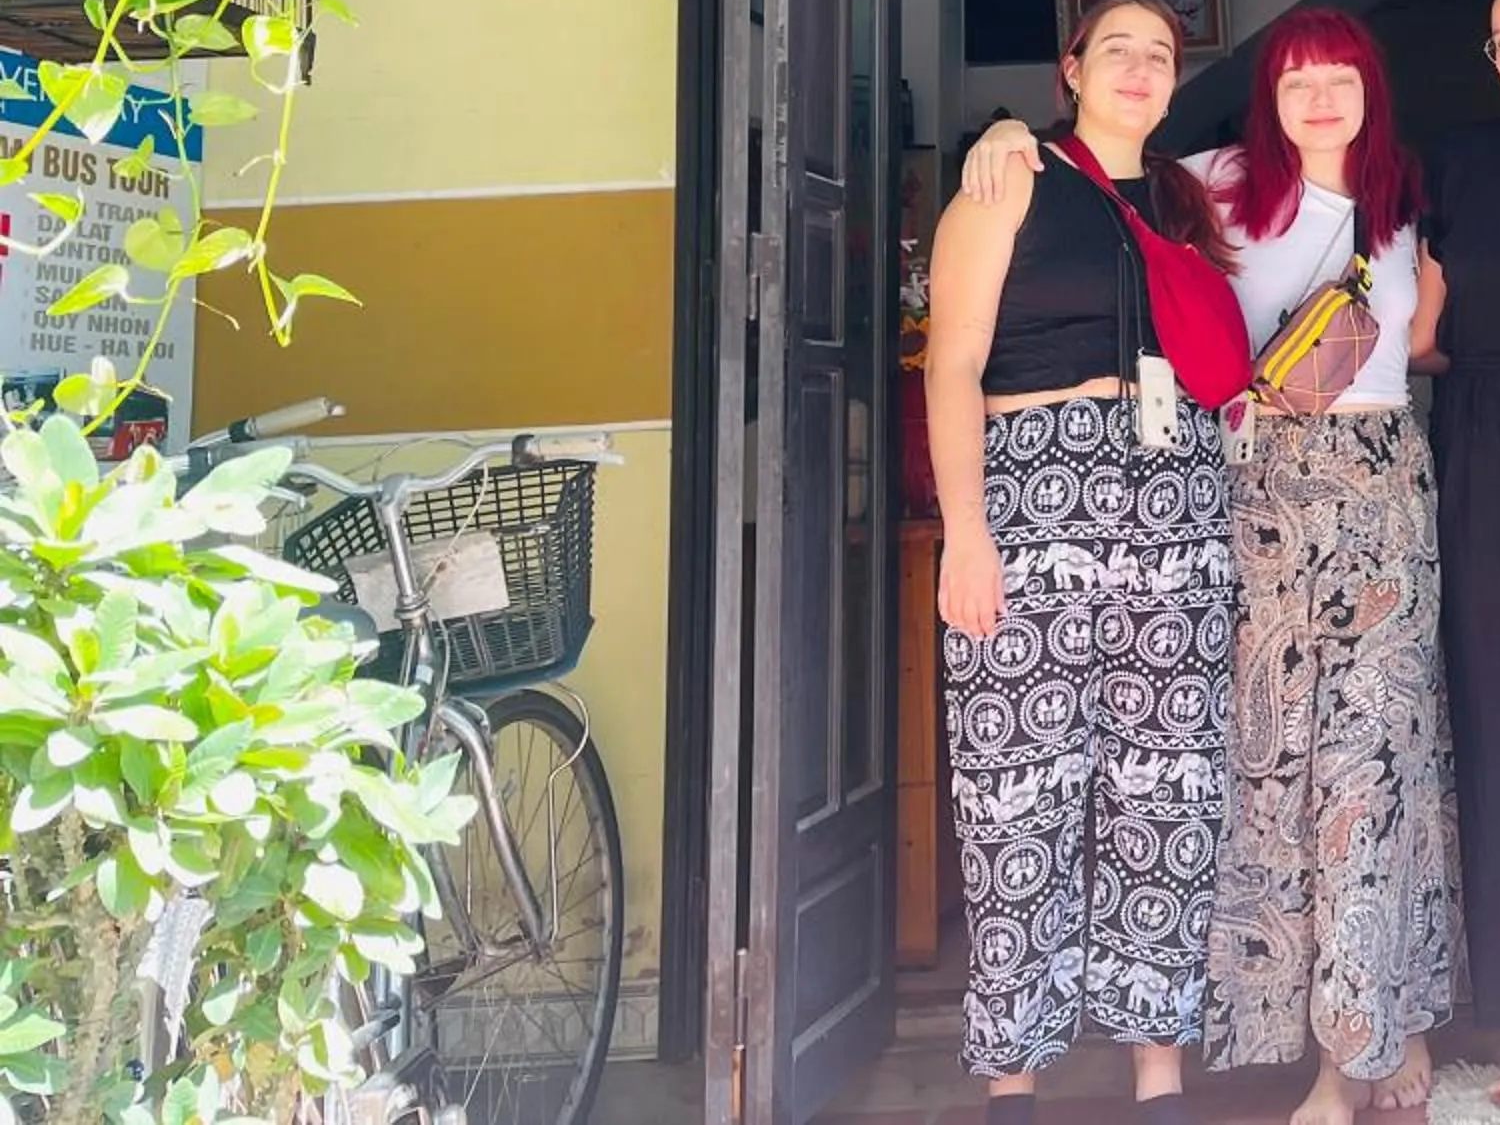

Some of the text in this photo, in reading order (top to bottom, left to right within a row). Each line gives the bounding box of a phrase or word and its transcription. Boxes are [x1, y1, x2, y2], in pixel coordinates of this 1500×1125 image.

[43, 145, 97, 186] BUS
[78, 222, 112, 244] LAT
[88, 314, 150, 335] NHON
[30, 333, 77, 354] HUE
[101, 339, 130, 359] HA
